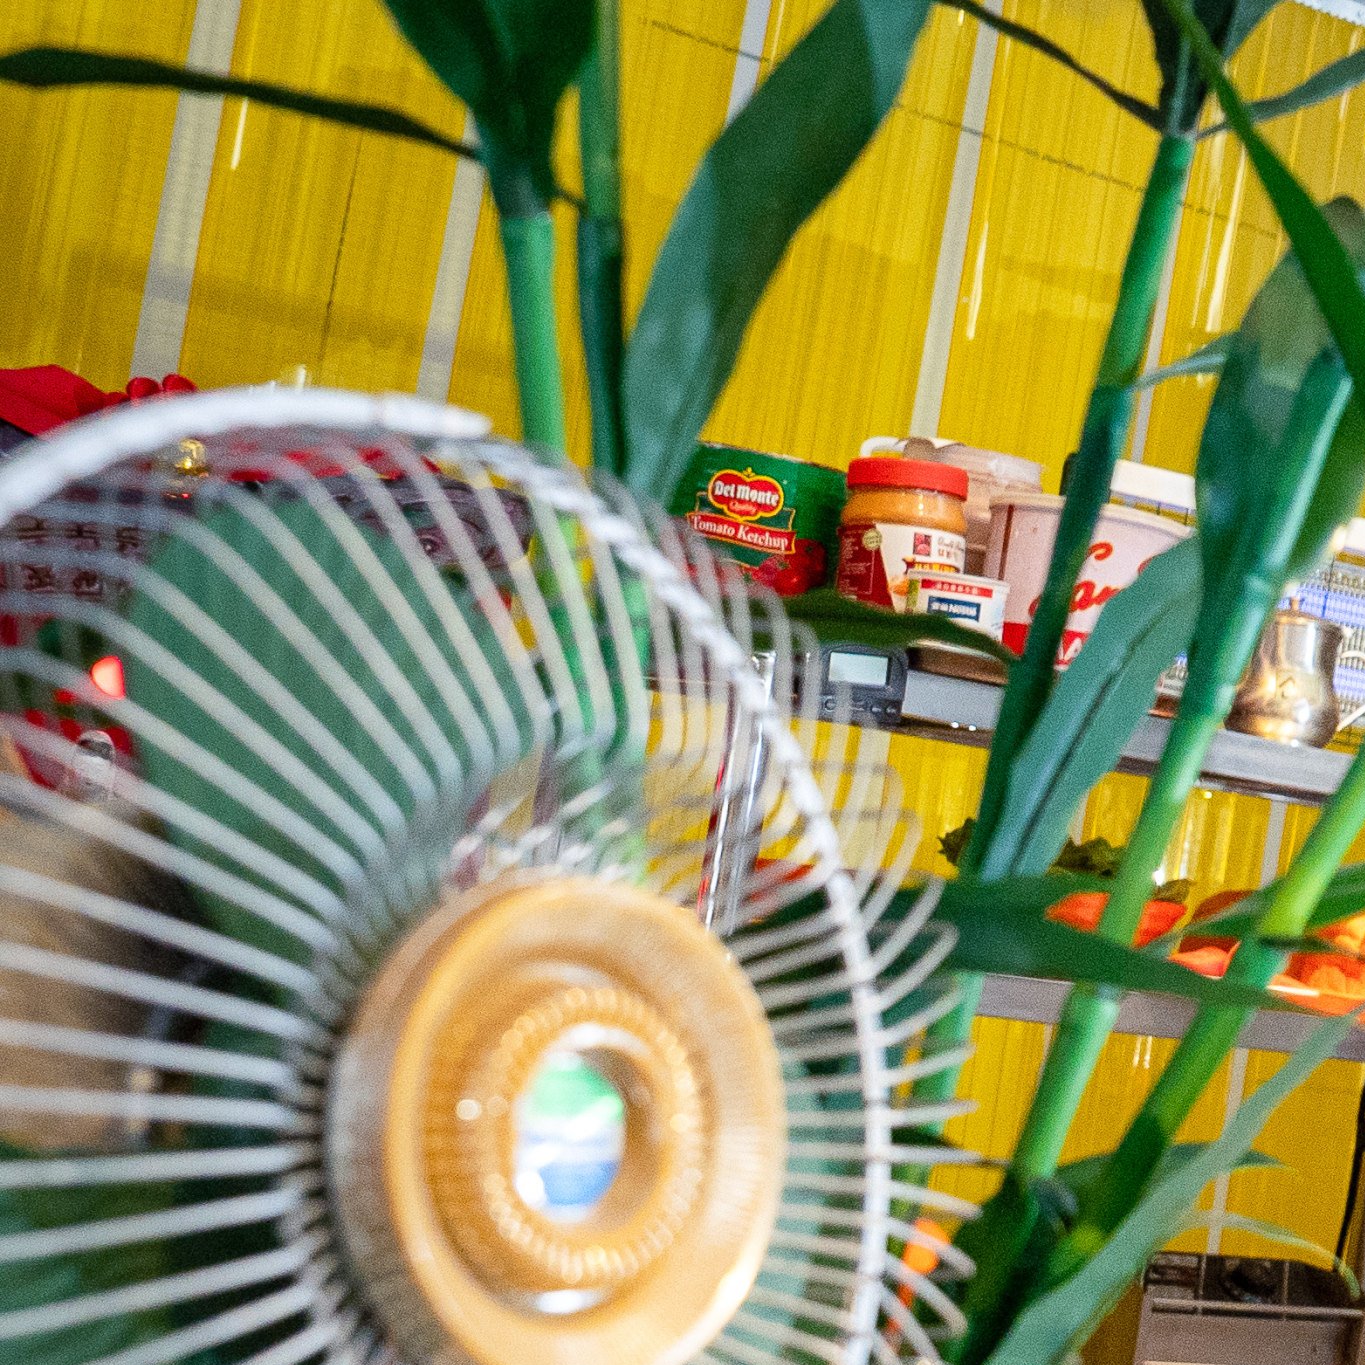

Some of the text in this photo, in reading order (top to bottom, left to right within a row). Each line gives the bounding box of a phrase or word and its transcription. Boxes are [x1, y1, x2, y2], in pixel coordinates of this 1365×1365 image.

[714, 480, 779, 507] Del Monte
[691, 514, 789, 551] Tomato Ketchup
